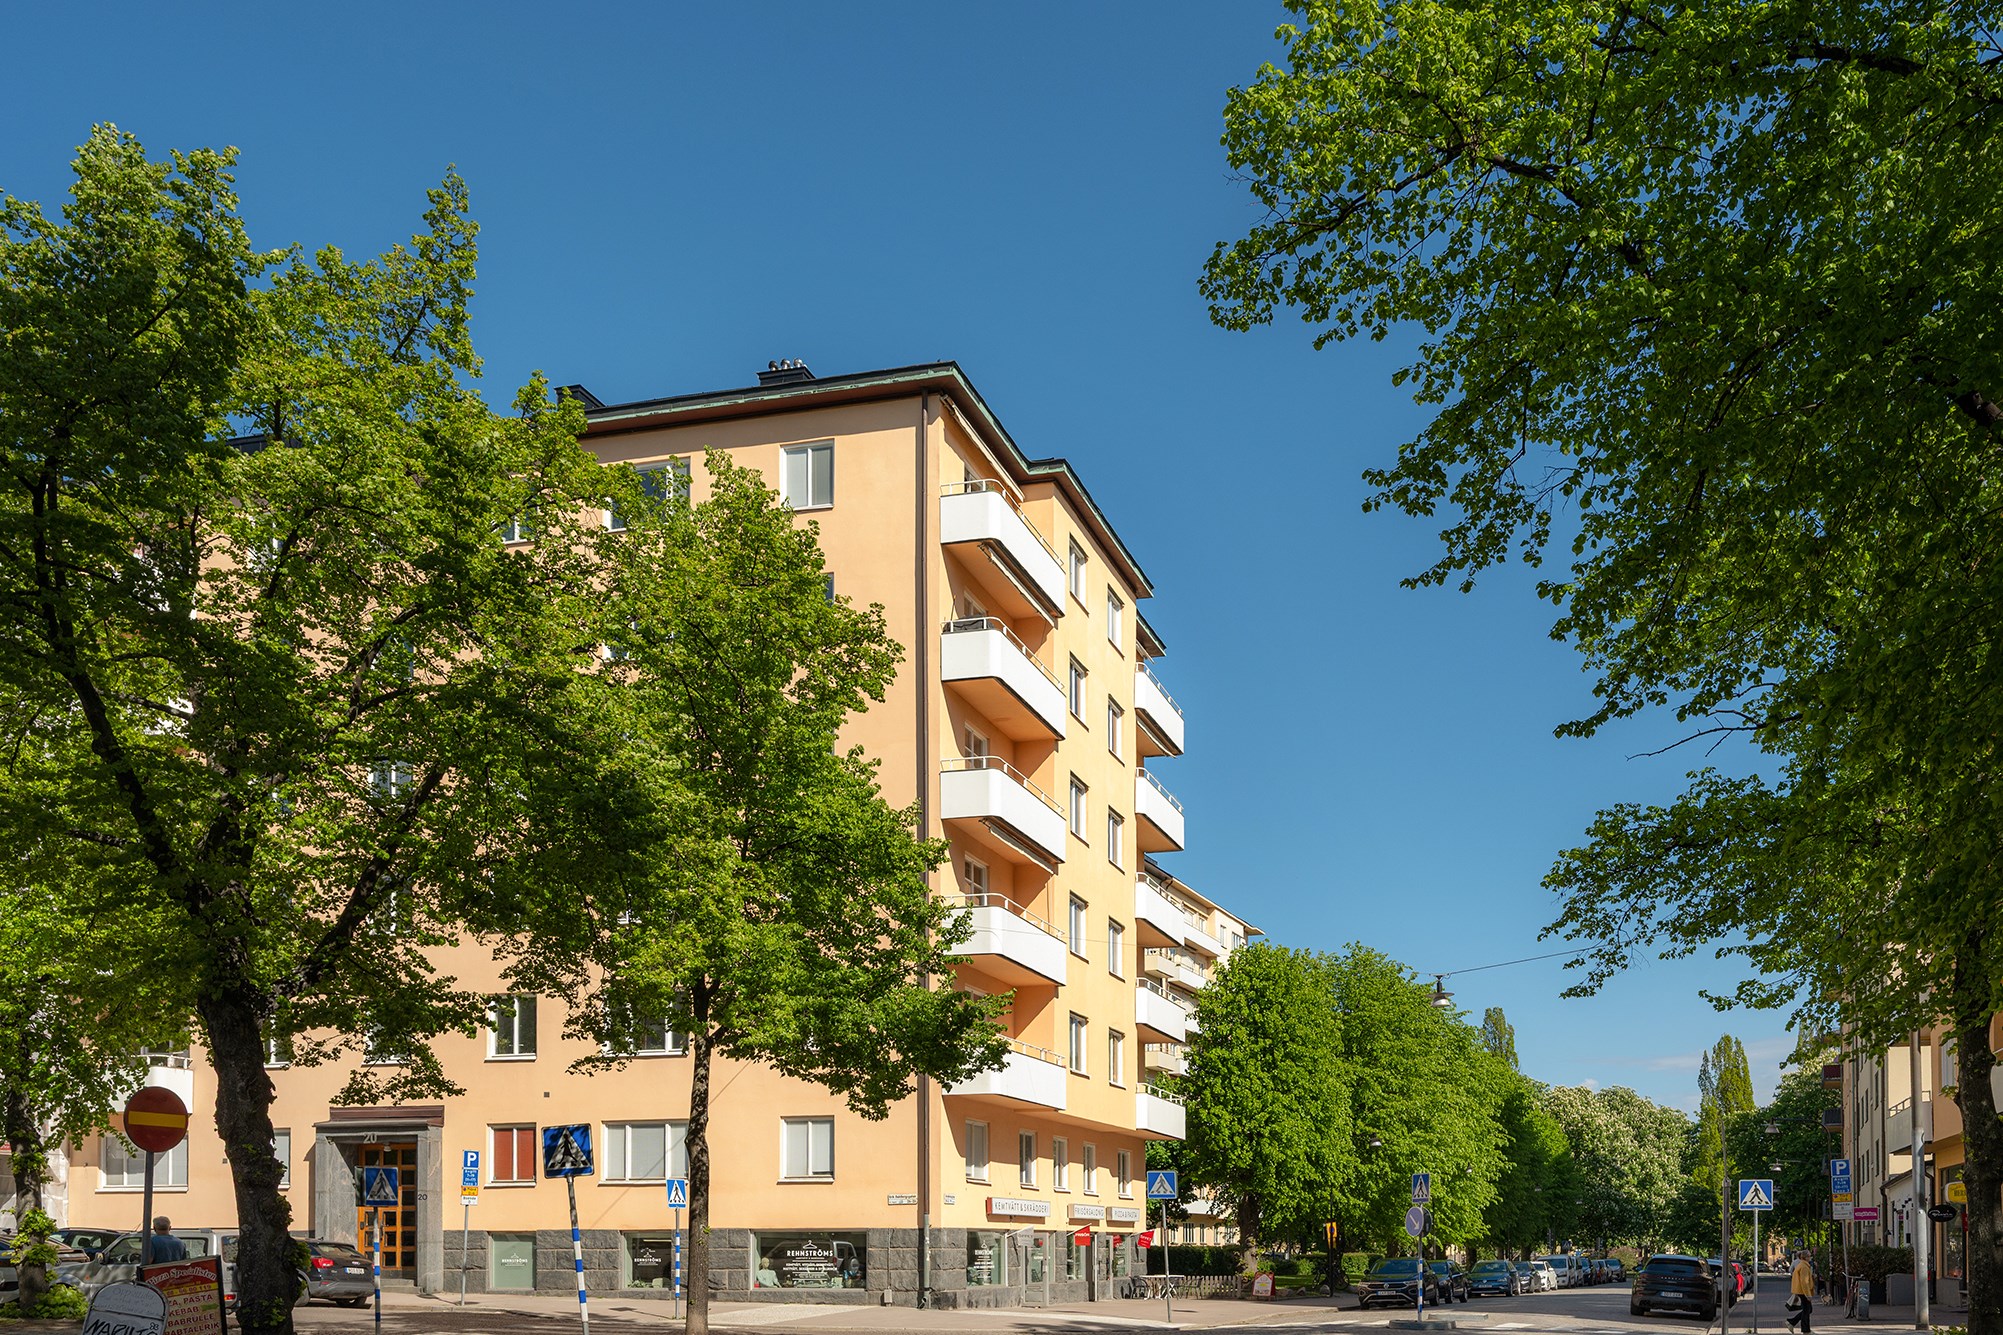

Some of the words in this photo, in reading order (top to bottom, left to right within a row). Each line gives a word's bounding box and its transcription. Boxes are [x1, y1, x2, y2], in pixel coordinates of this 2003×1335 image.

[363, 1133, 377, 1144] 20
[467, 1152, 477, 1167] P
[1836, 1161, 1847, 1175] P
[787, 1249, 833, 1257] REHNSTRÖMS
[169, 1266, 217, 1281] Specialisten
[183, 1294, 213, 1304] PASTA
[167, 1313, 215, 1328] BABRULLE
